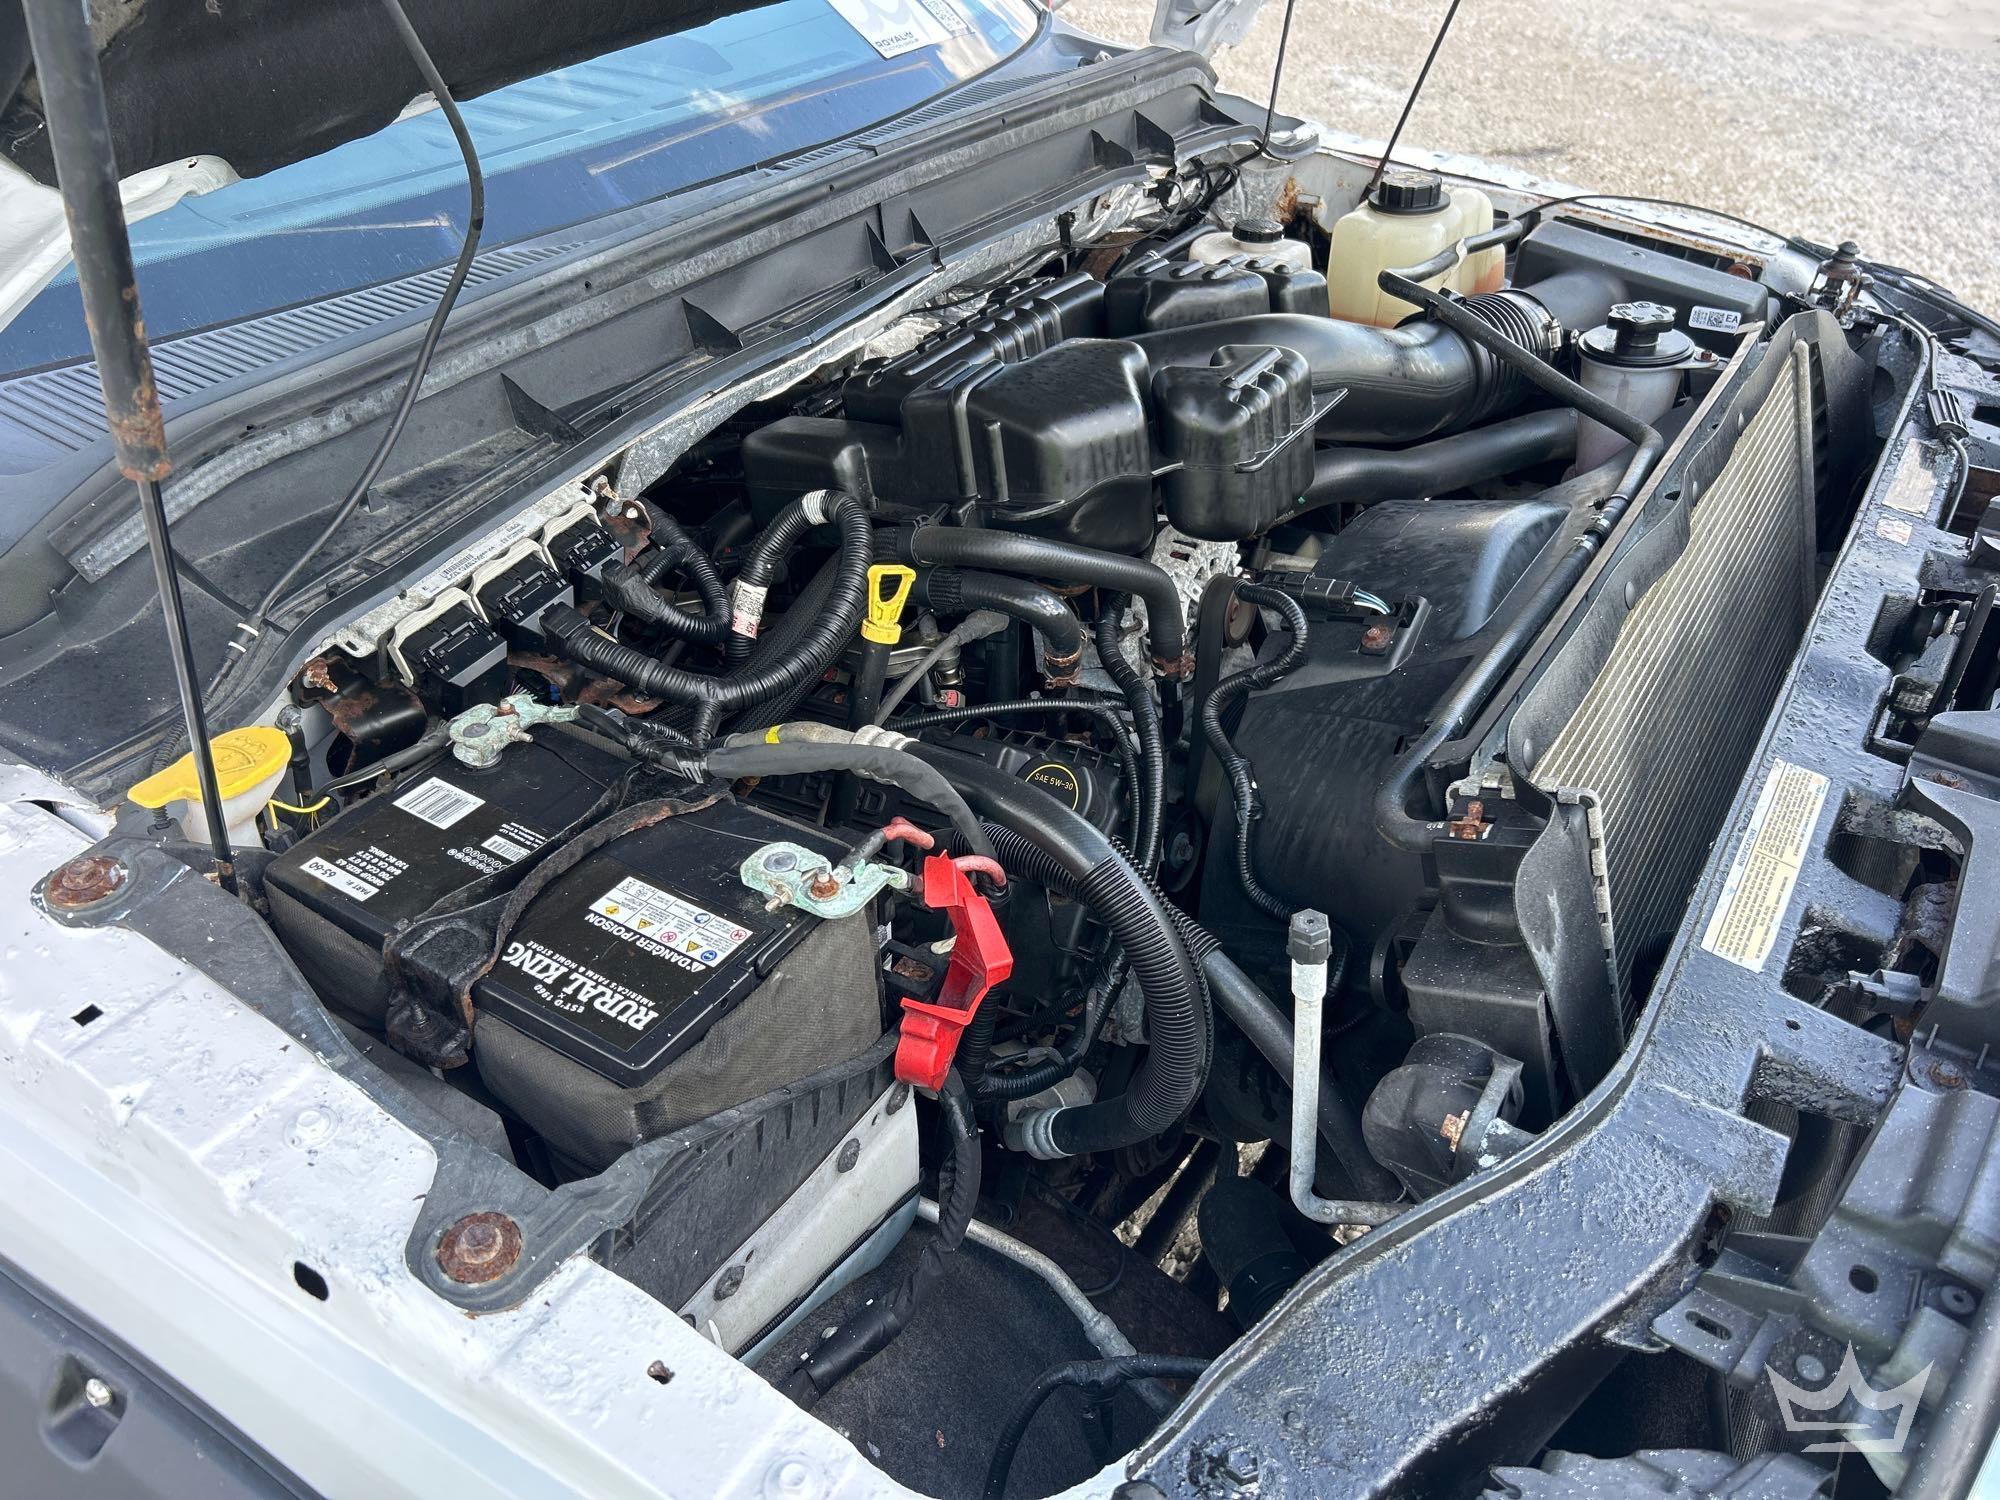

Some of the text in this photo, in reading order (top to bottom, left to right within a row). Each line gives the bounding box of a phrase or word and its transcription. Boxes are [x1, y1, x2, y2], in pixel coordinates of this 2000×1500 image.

[1725, 314, 1737, 323] EA
[1034, 773, 1073, 791] SAE 5W-30
[799, 775, 887, 816] FOD
[1737, 828, 1756, 866] MODIFICATIONS
[308, 862, 335, 878] 65-60
[345, 863, 362, 874] SIZE:
[365, 864, 380, 874] CCA
[377, 871, 393, 880] 700
[359, 871, 385, 886] GROUP
[353, 884, 370, 895] PART
[526, 940, 553, 956] STORE
[551, 953, 577, 968] HOME
[501, 940, 659, 1030] RURAL KING
[584, 970, 610, 985] FARM
[533, 983, 553, 1001] 1960
[608, 981, 655, 1007] AMERICA'S
